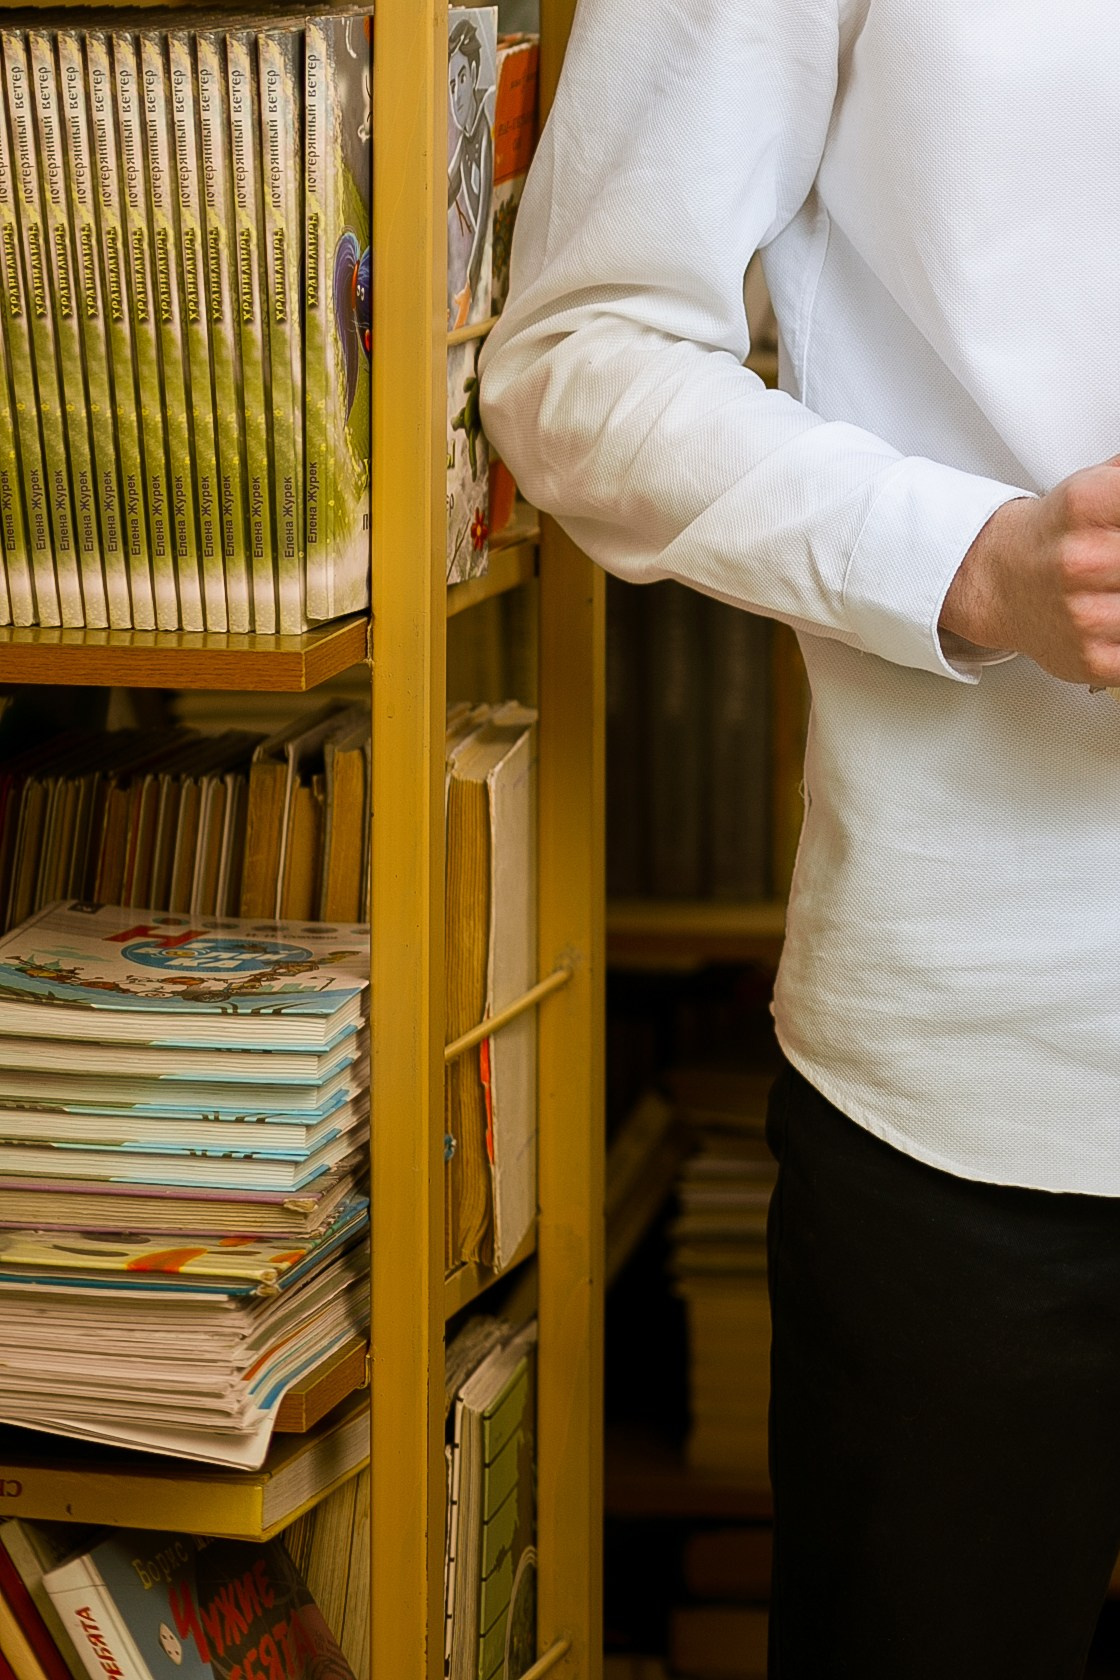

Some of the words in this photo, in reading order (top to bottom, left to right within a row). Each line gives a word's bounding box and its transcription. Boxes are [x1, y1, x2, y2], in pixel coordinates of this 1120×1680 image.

[1, 470, 12, 510] Журек
[30, 470, 43, 510] Журек
[55, 470, 66, 510] Журек
[79, 471, 91, 511] Журек
[104, 471, 115, 511] Журек
[127, 474, 139, 515] Журек
[152, 475, 164, 516] Журек
[175, 476, 186, 516] Журек
[201, 476, 213, 516] Журек
[223, 475, 234, 516] Журек
[252, 477, 263, 518] Журек
[283, 477, 295, 517] Журек
[308, 462, 319, 502] Журек
[7, 514, 16, 551] Елена
[36, 514, 46, 550] Елена
[60, 514, 70, 551] Елена
[84, 515, 94, 552] Елена
[108, 515, 118, 552] Елена
[131, 519, 141, 556] Елена
[156, 520, 165, 556] Елена
[178, 520, 188, 557] Елена
[204, 520, 214, 557] Елена
[226, 520, 234, 557] Елена
[254, 521, 264, 558] Елена
[285, 521, 294, 558] Елена
[308, 507, 317, 544] Елена
[130, 1540, 190, 1591] Борис
